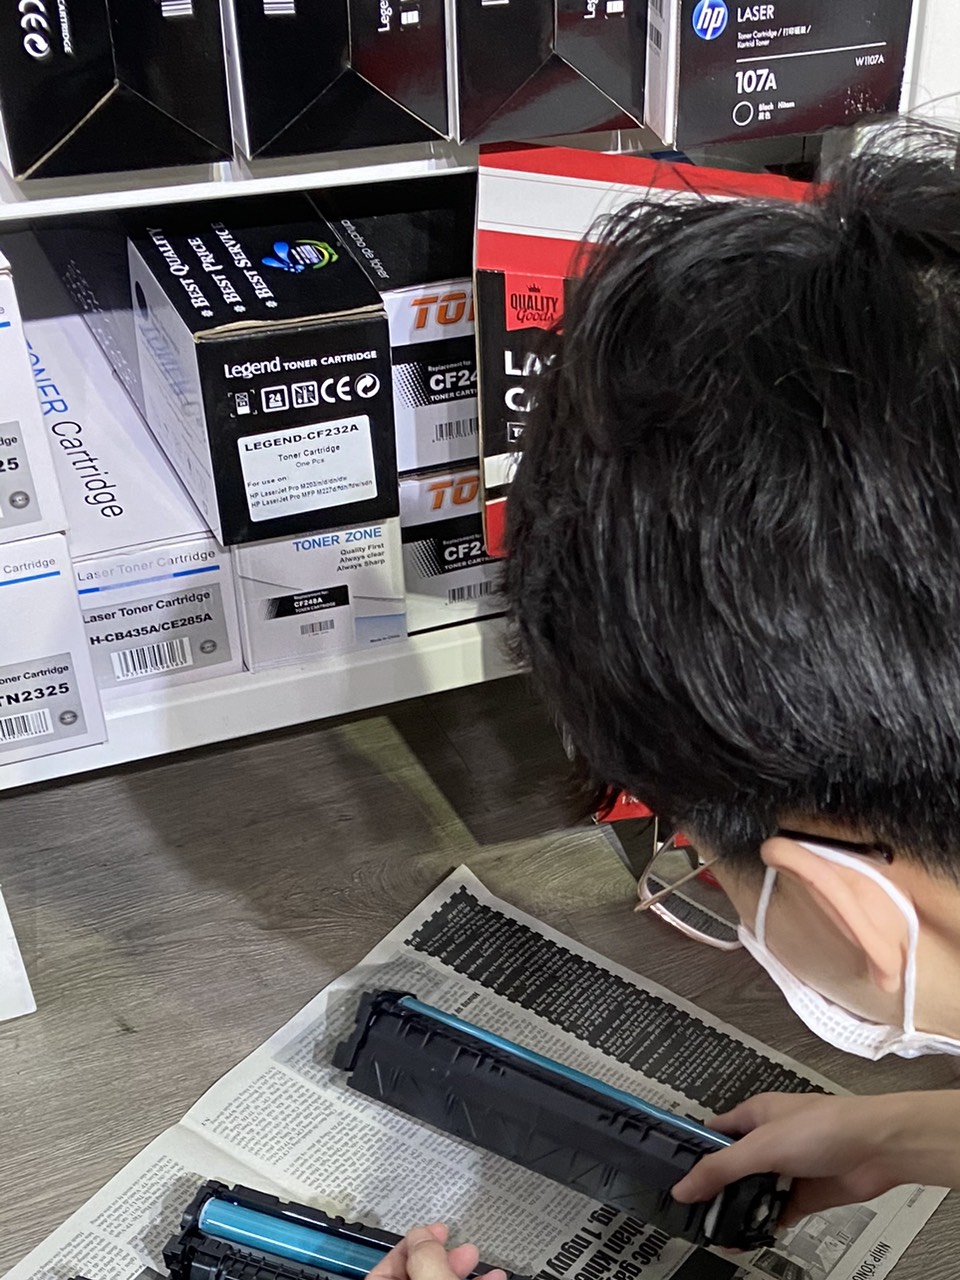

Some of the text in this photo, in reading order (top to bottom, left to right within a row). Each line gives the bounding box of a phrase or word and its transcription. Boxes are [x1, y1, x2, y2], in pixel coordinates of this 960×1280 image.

[378, 0, 393, 32] Lege
[737, 5, 774, 23] LASER
[752, 29, 778, 39] Cartridge
[855, 54, 885, 67] W1107A
[735, 68, 777, 94] 107A
[146, 226, 190, 277] QUALITY
[211, 222, 275, 302] BEST SERVICE
[187, 237, 243, 304] BEST PRICE
[180, 278, 210, 309] BEST
[510, 293, 559, 313] QUALITY
[411, 292, 475, 330] TO
[224, 350, 378, 379] Legend TONER CARTRIDGE
[430, 393, 455, 401] TONER
[244, 424, 360, 452] LEGEND-CF232A
[278, 444, 341, 462] Toner Cartridge
[51, 421, 125, 518] Cartridge
[293, 527, 382, 552] TONER ZONE
[340, 543, 385, 556] Quality First
[444, 541, 487, 561] CF2
[3, 557, 56, 574] Cartridge
[77, 550, 216, 582] Laser Toner Cartridge
[337, 559, 386, 572] Always Sharp
[339, 550, 385, 564] Always clear
[445, 561, 467, 570] TONER
[82, 591, 211, 624] Laser Toner Cartridge
[90, 612, 213, 645] H-CB435A/CE285A
[23, 664, 70, 680] Cartridge
[581, 1222, 603, 1242] 1
[546, 1229, 591, 1277] nguy
